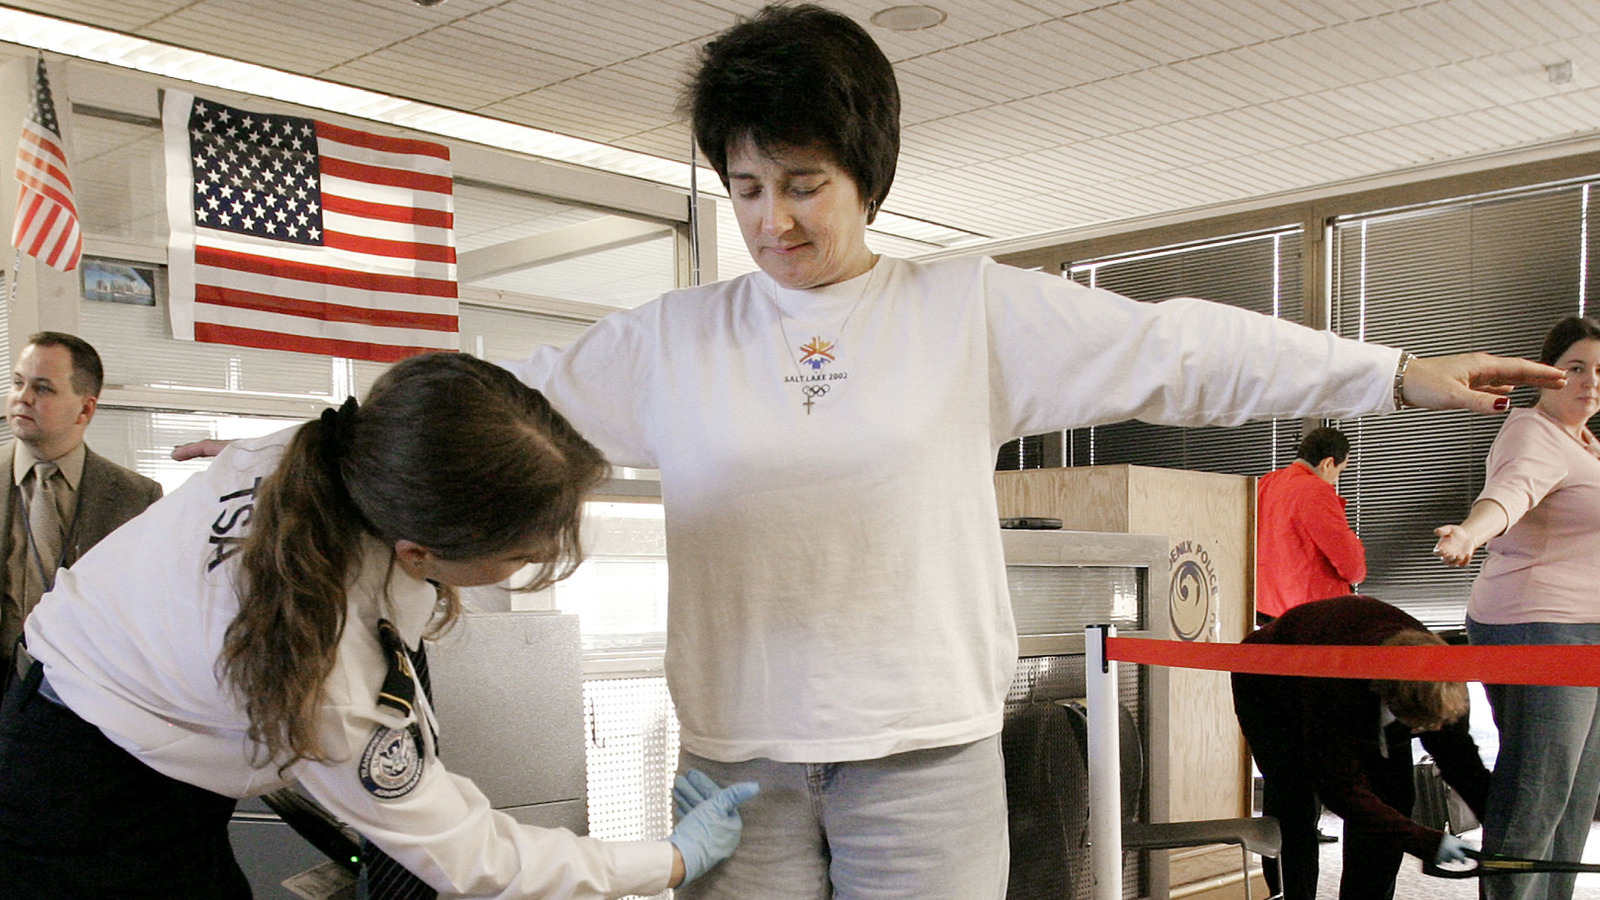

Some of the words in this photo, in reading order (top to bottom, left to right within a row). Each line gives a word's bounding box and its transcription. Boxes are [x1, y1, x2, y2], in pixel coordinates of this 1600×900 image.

[806, 374, 826, 382] LAKE
[828, 372, 848, 381] 2002
[207, 476, 262, 573] TSA
[1195, 543, 1218, 596] POLICE
